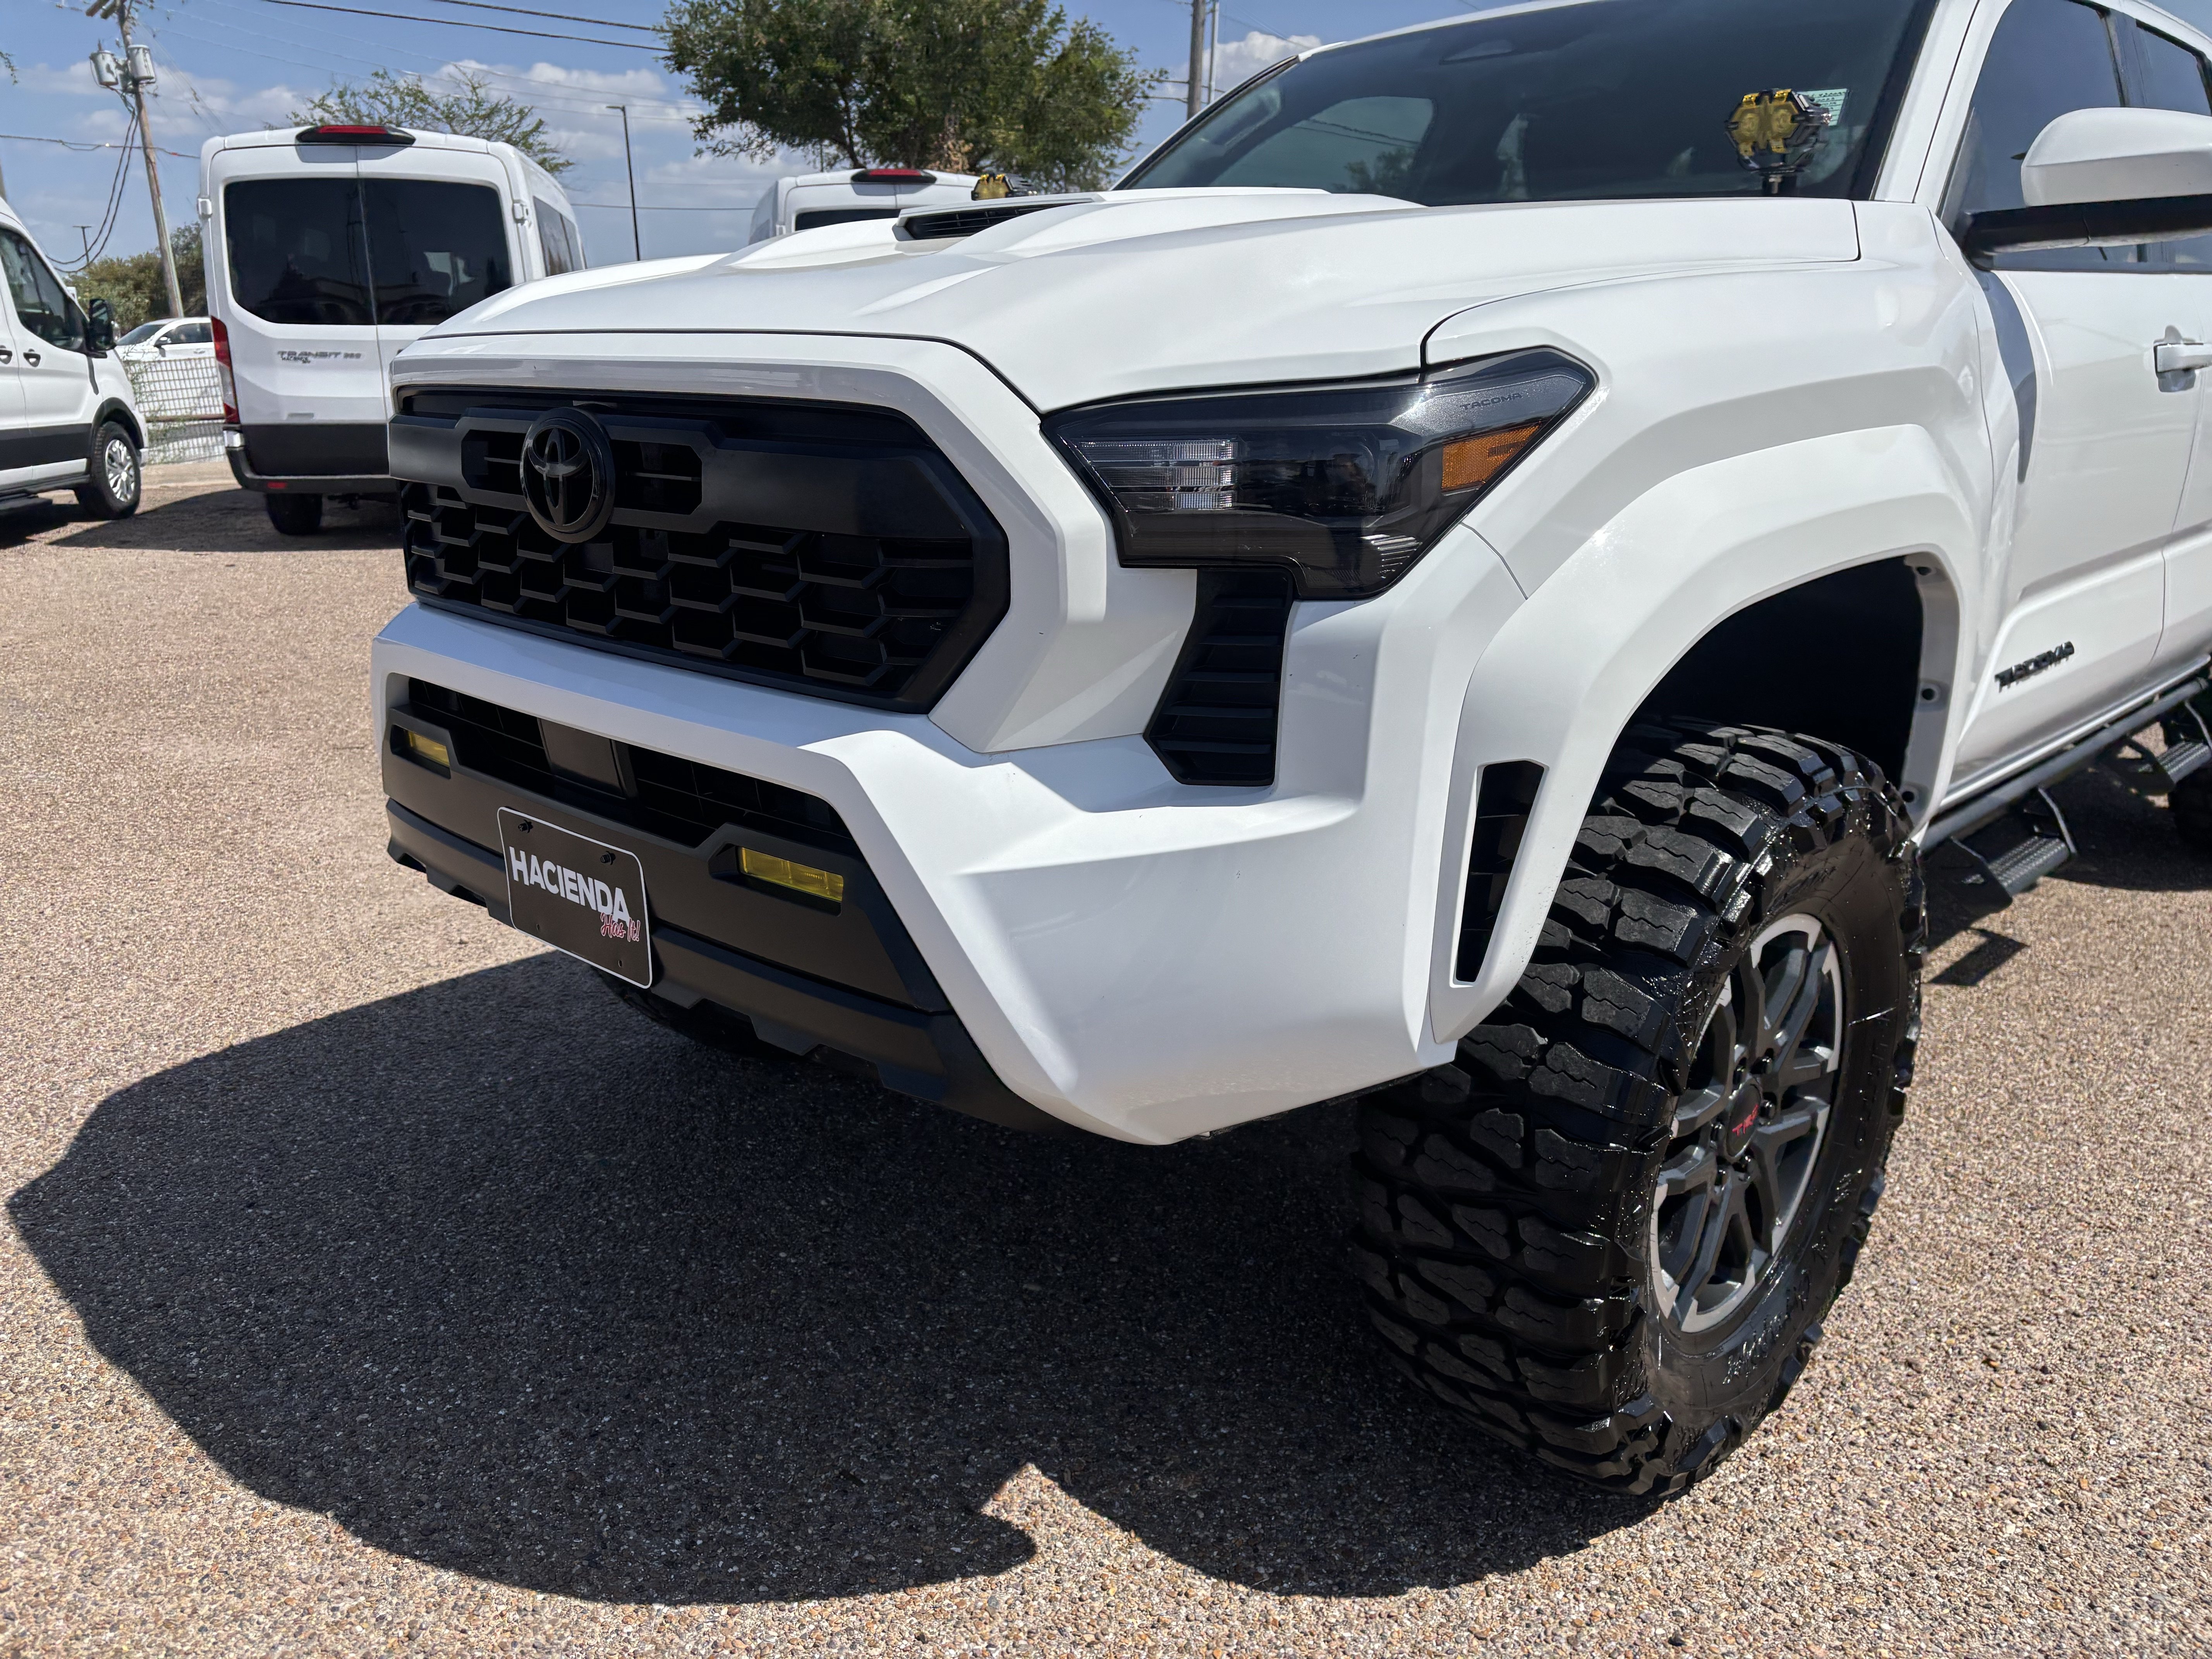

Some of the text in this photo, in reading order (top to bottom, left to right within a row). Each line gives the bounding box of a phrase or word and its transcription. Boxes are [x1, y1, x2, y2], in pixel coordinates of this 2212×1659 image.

[277, 350, 342, 359] TRANSIT
[1459, 392, 1523, 410] TACOMA
[509, 846, 630, 927] HACIENDA
[600, 912, 641, 942] Has It!
